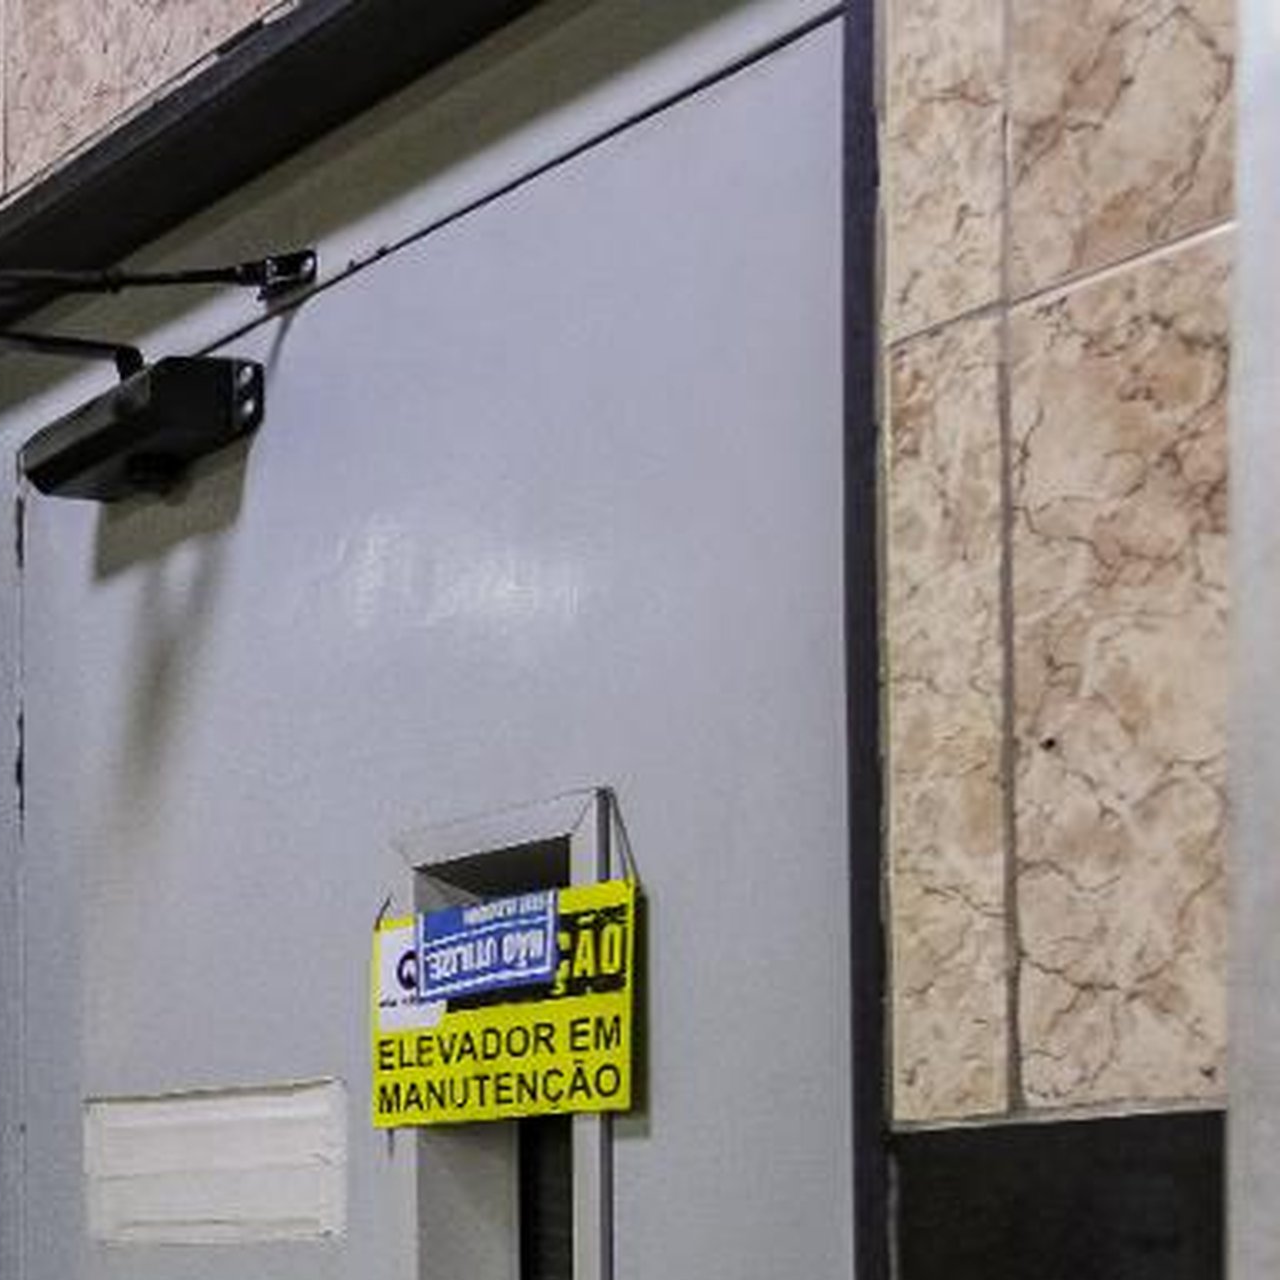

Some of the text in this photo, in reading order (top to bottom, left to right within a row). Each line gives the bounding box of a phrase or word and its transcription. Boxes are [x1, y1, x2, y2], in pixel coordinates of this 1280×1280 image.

[378, 1015, 621, 1071] ELEVADOR EM
[378, 1060, 621, 1114] MANUTENÇÃO
